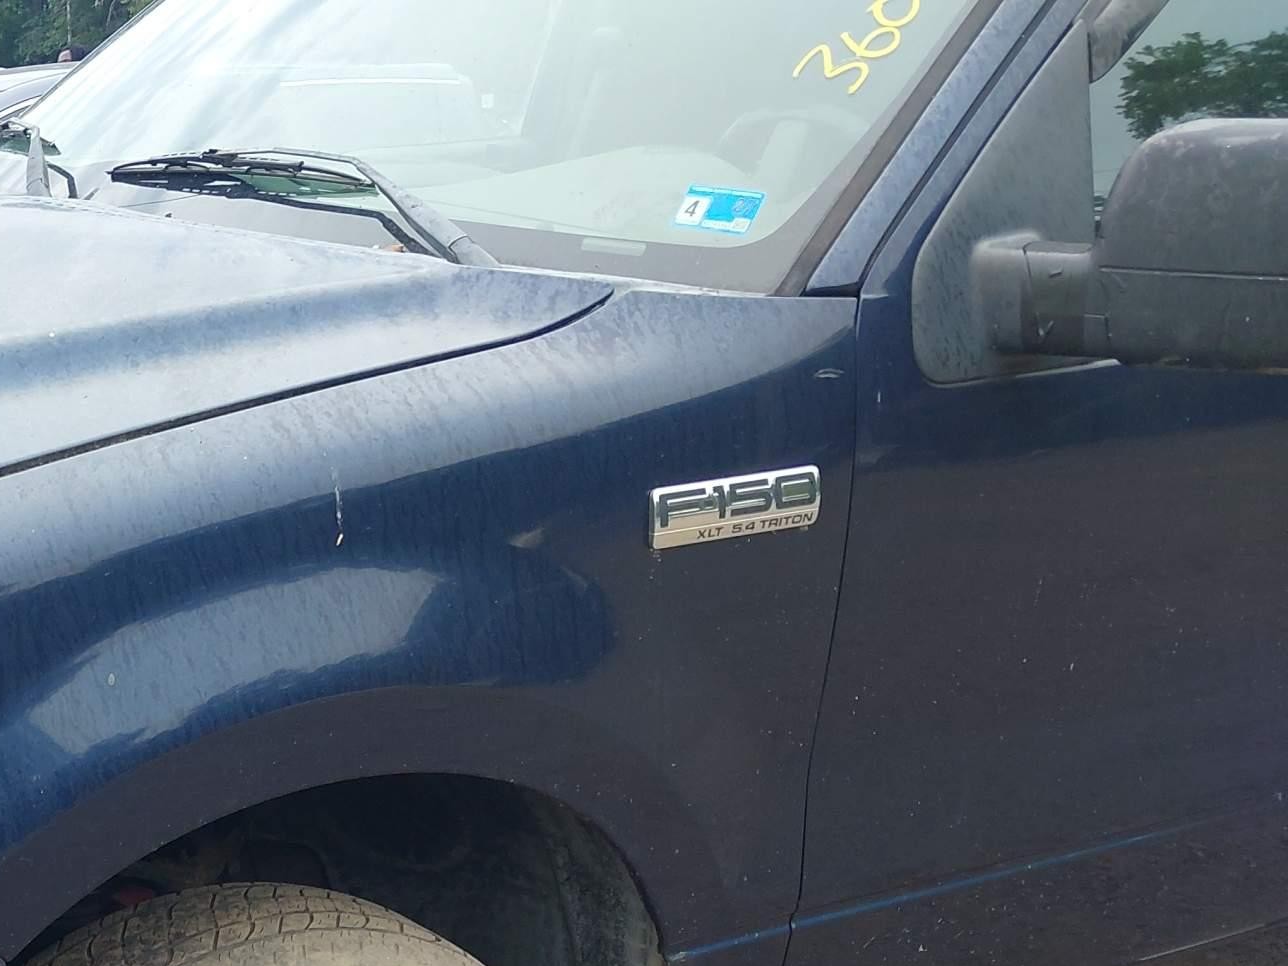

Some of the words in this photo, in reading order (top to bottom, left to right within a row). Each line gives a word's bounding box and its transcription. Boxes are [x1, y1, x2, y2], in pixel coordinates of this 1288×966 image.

[684, 199, 701, 217] 4
[696, 526, 724, 540] XLT
[731, 521, 756, 534] 5.4
[759, 511, 814, 530] TRITON
